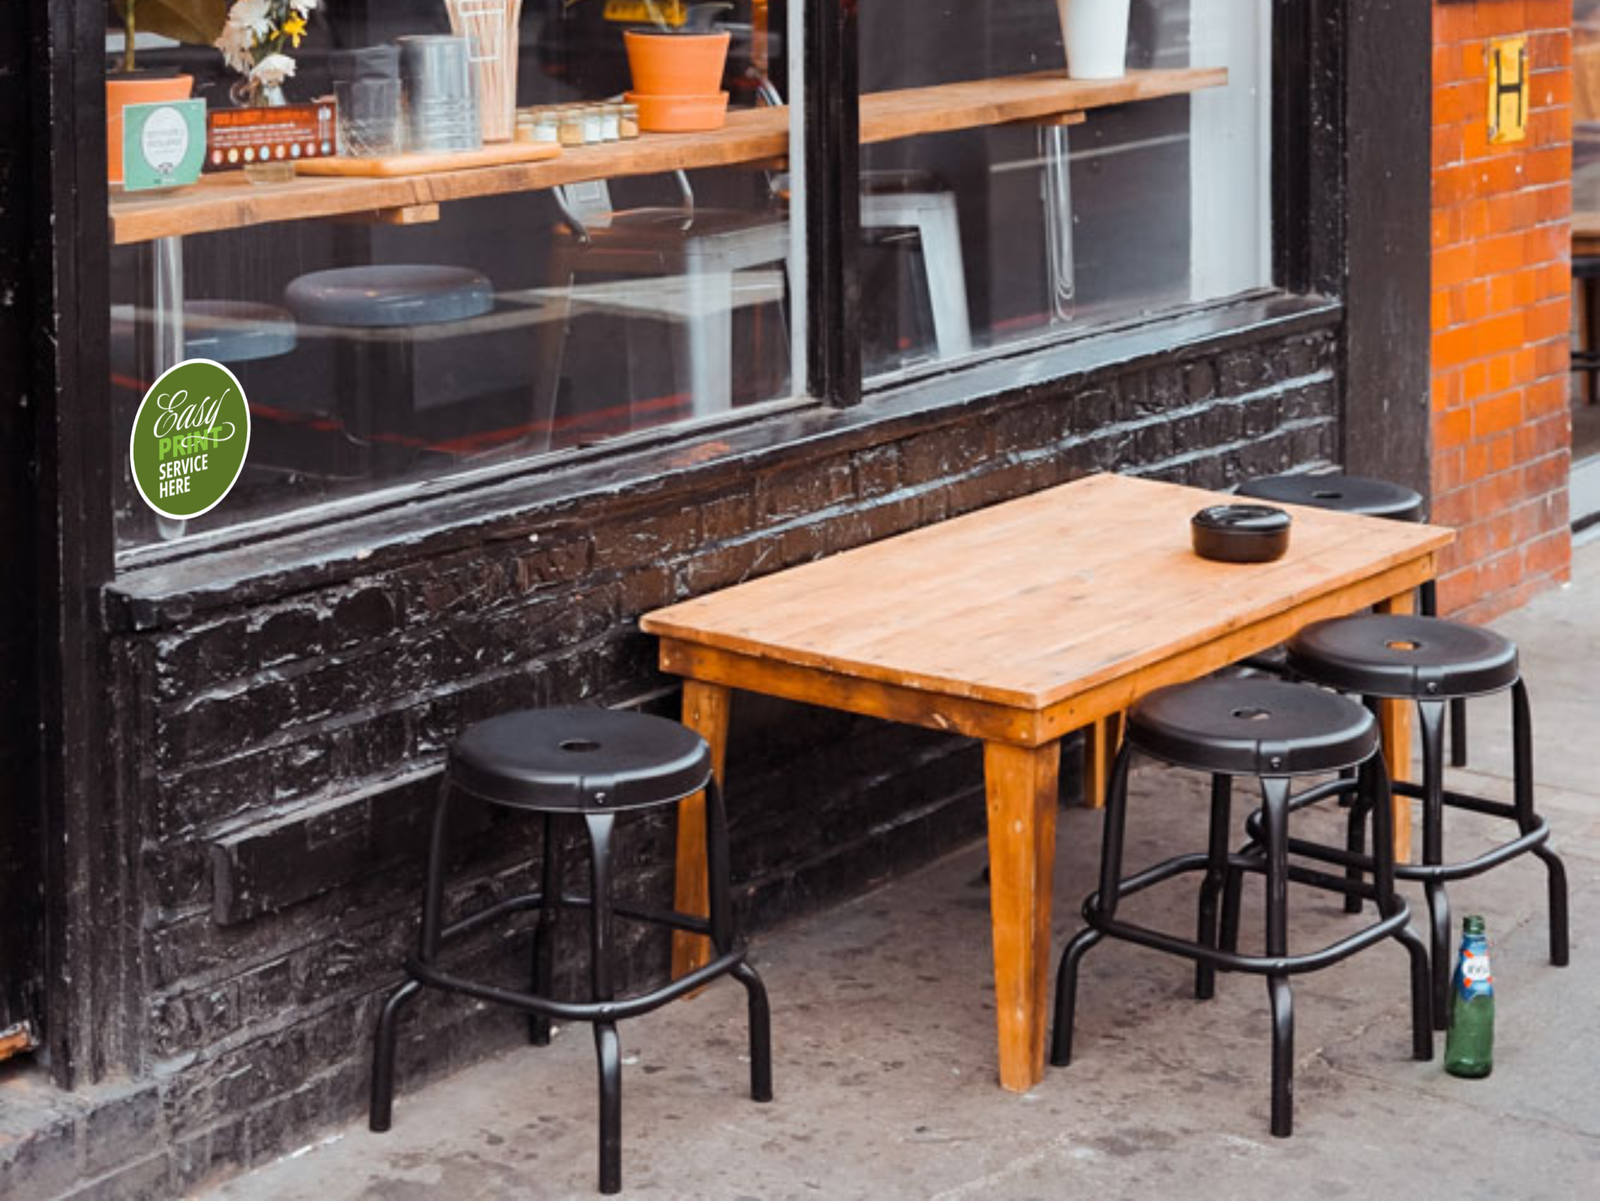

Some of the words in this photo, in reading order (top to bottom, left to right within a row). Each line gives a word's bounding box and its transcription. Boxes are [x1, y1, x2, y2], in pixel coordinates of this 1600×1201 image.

[1495, 48, 1523, 131] H
[153, 388, 235, 448] Easy
[158, 426, 222, 461] PRINT
[159, 453, 209, 480] SERVICE
[159, 476, 191, 499] HERE
